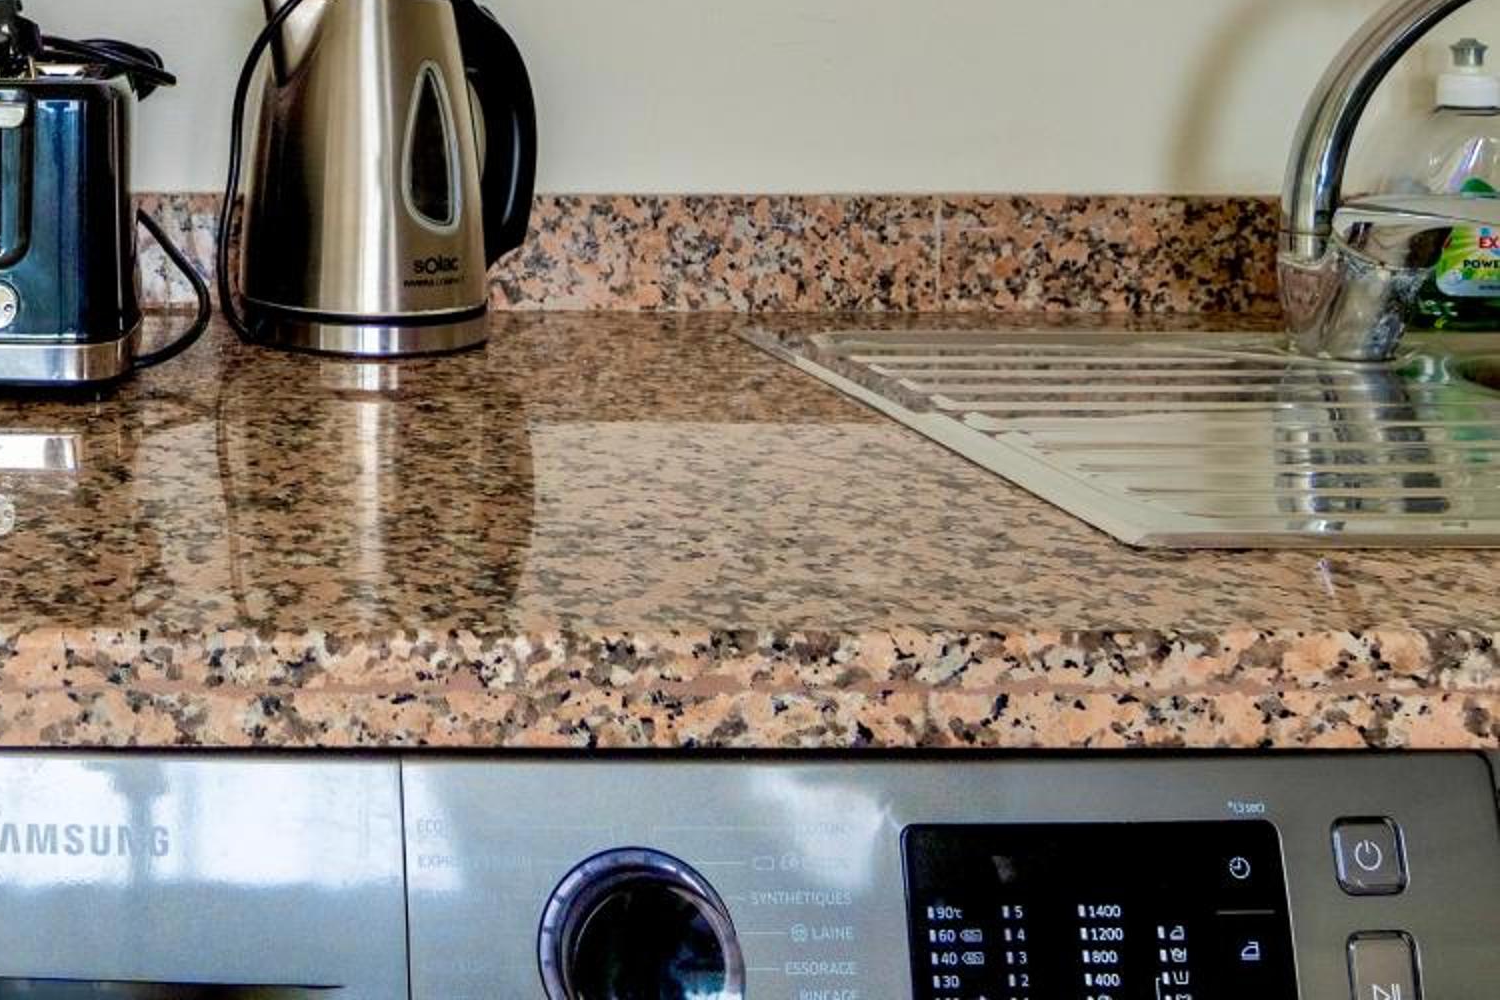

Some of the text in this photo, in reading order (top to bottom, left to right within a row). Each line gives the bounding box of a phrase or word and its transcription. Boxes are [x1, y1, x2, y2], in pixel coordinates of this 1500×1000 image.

[1014, 905, 1024, 919] 5
[1088, 905, 1122, 918] 1400
[938, 929, 956, 943] 60
[1017, 928, 1026, 942] 4
[1090, 927, 1124, 941] 1200
[941, 951, 959, 965] 40
[1019, 951, 1028, 966] 3
[1092, 949, 1119, 963] 800
[942, 975, 960, 989] 30
[1021, 974, 1030, 988] 2
[1095, 973, 1121, 987] 400
